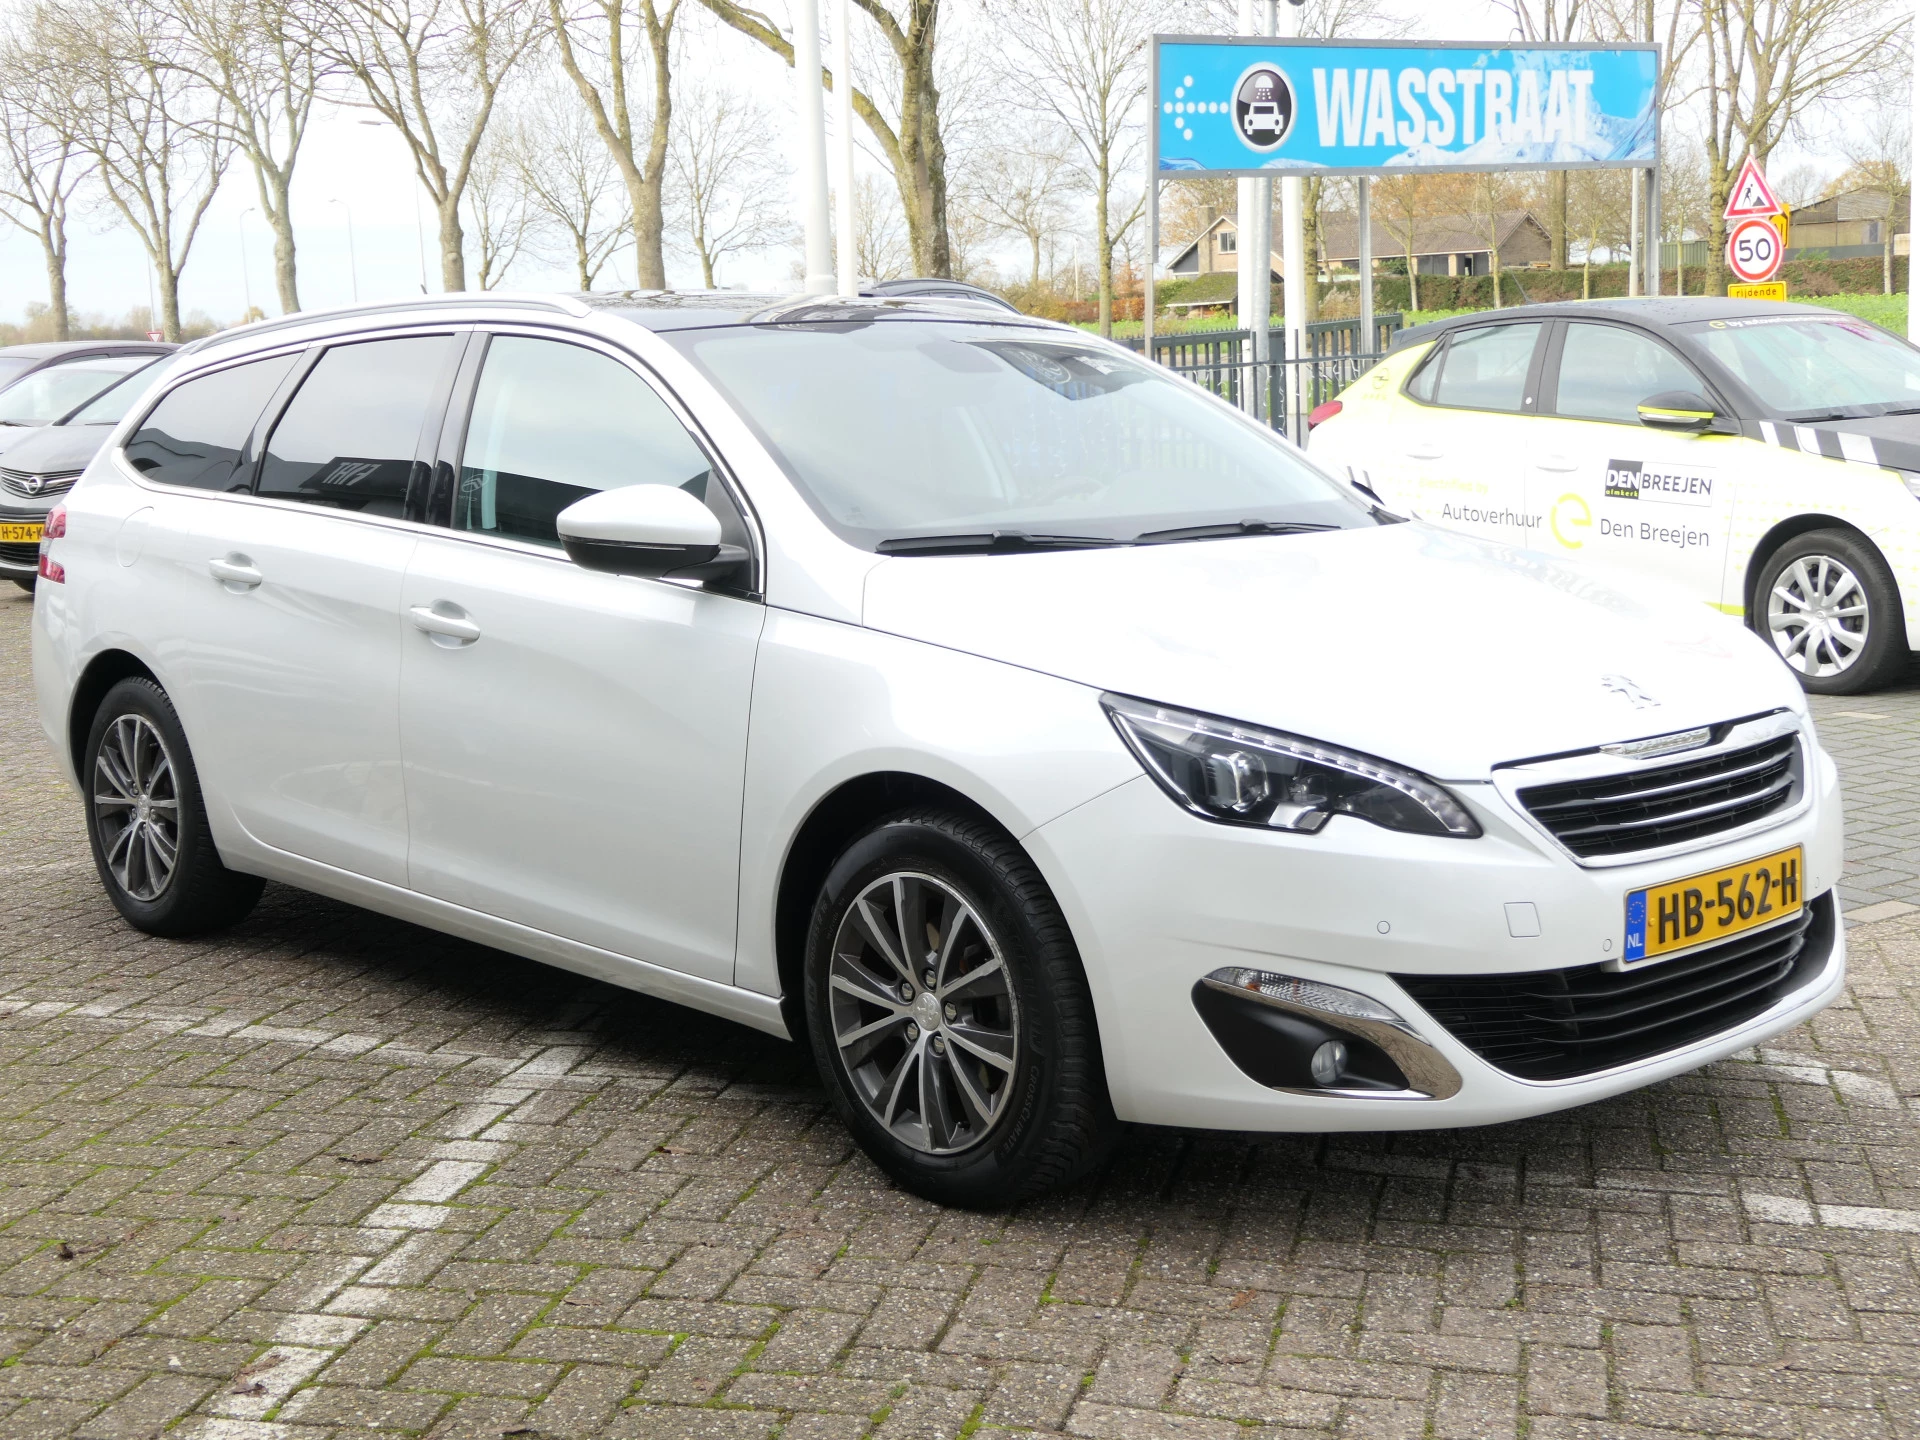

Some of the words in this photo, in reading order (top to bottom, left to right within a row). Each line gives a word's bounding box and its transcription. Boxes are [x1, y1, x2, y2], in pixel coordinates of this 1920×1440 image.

[1312, 67, 1594, 147] WASSTRAAT
[1739, 237, 1772, 262] 50
[1736, 287, 1778, 299] rijdende
[1442, 503, 1542, 529] Autoverhuur
[1600, 518, 1633, 538] Den
[1640, 522, 1709, 549] Breejen
[1658, 858, 1797, 945] HB-562-H
[1627, 932, 1643, 949] NL
